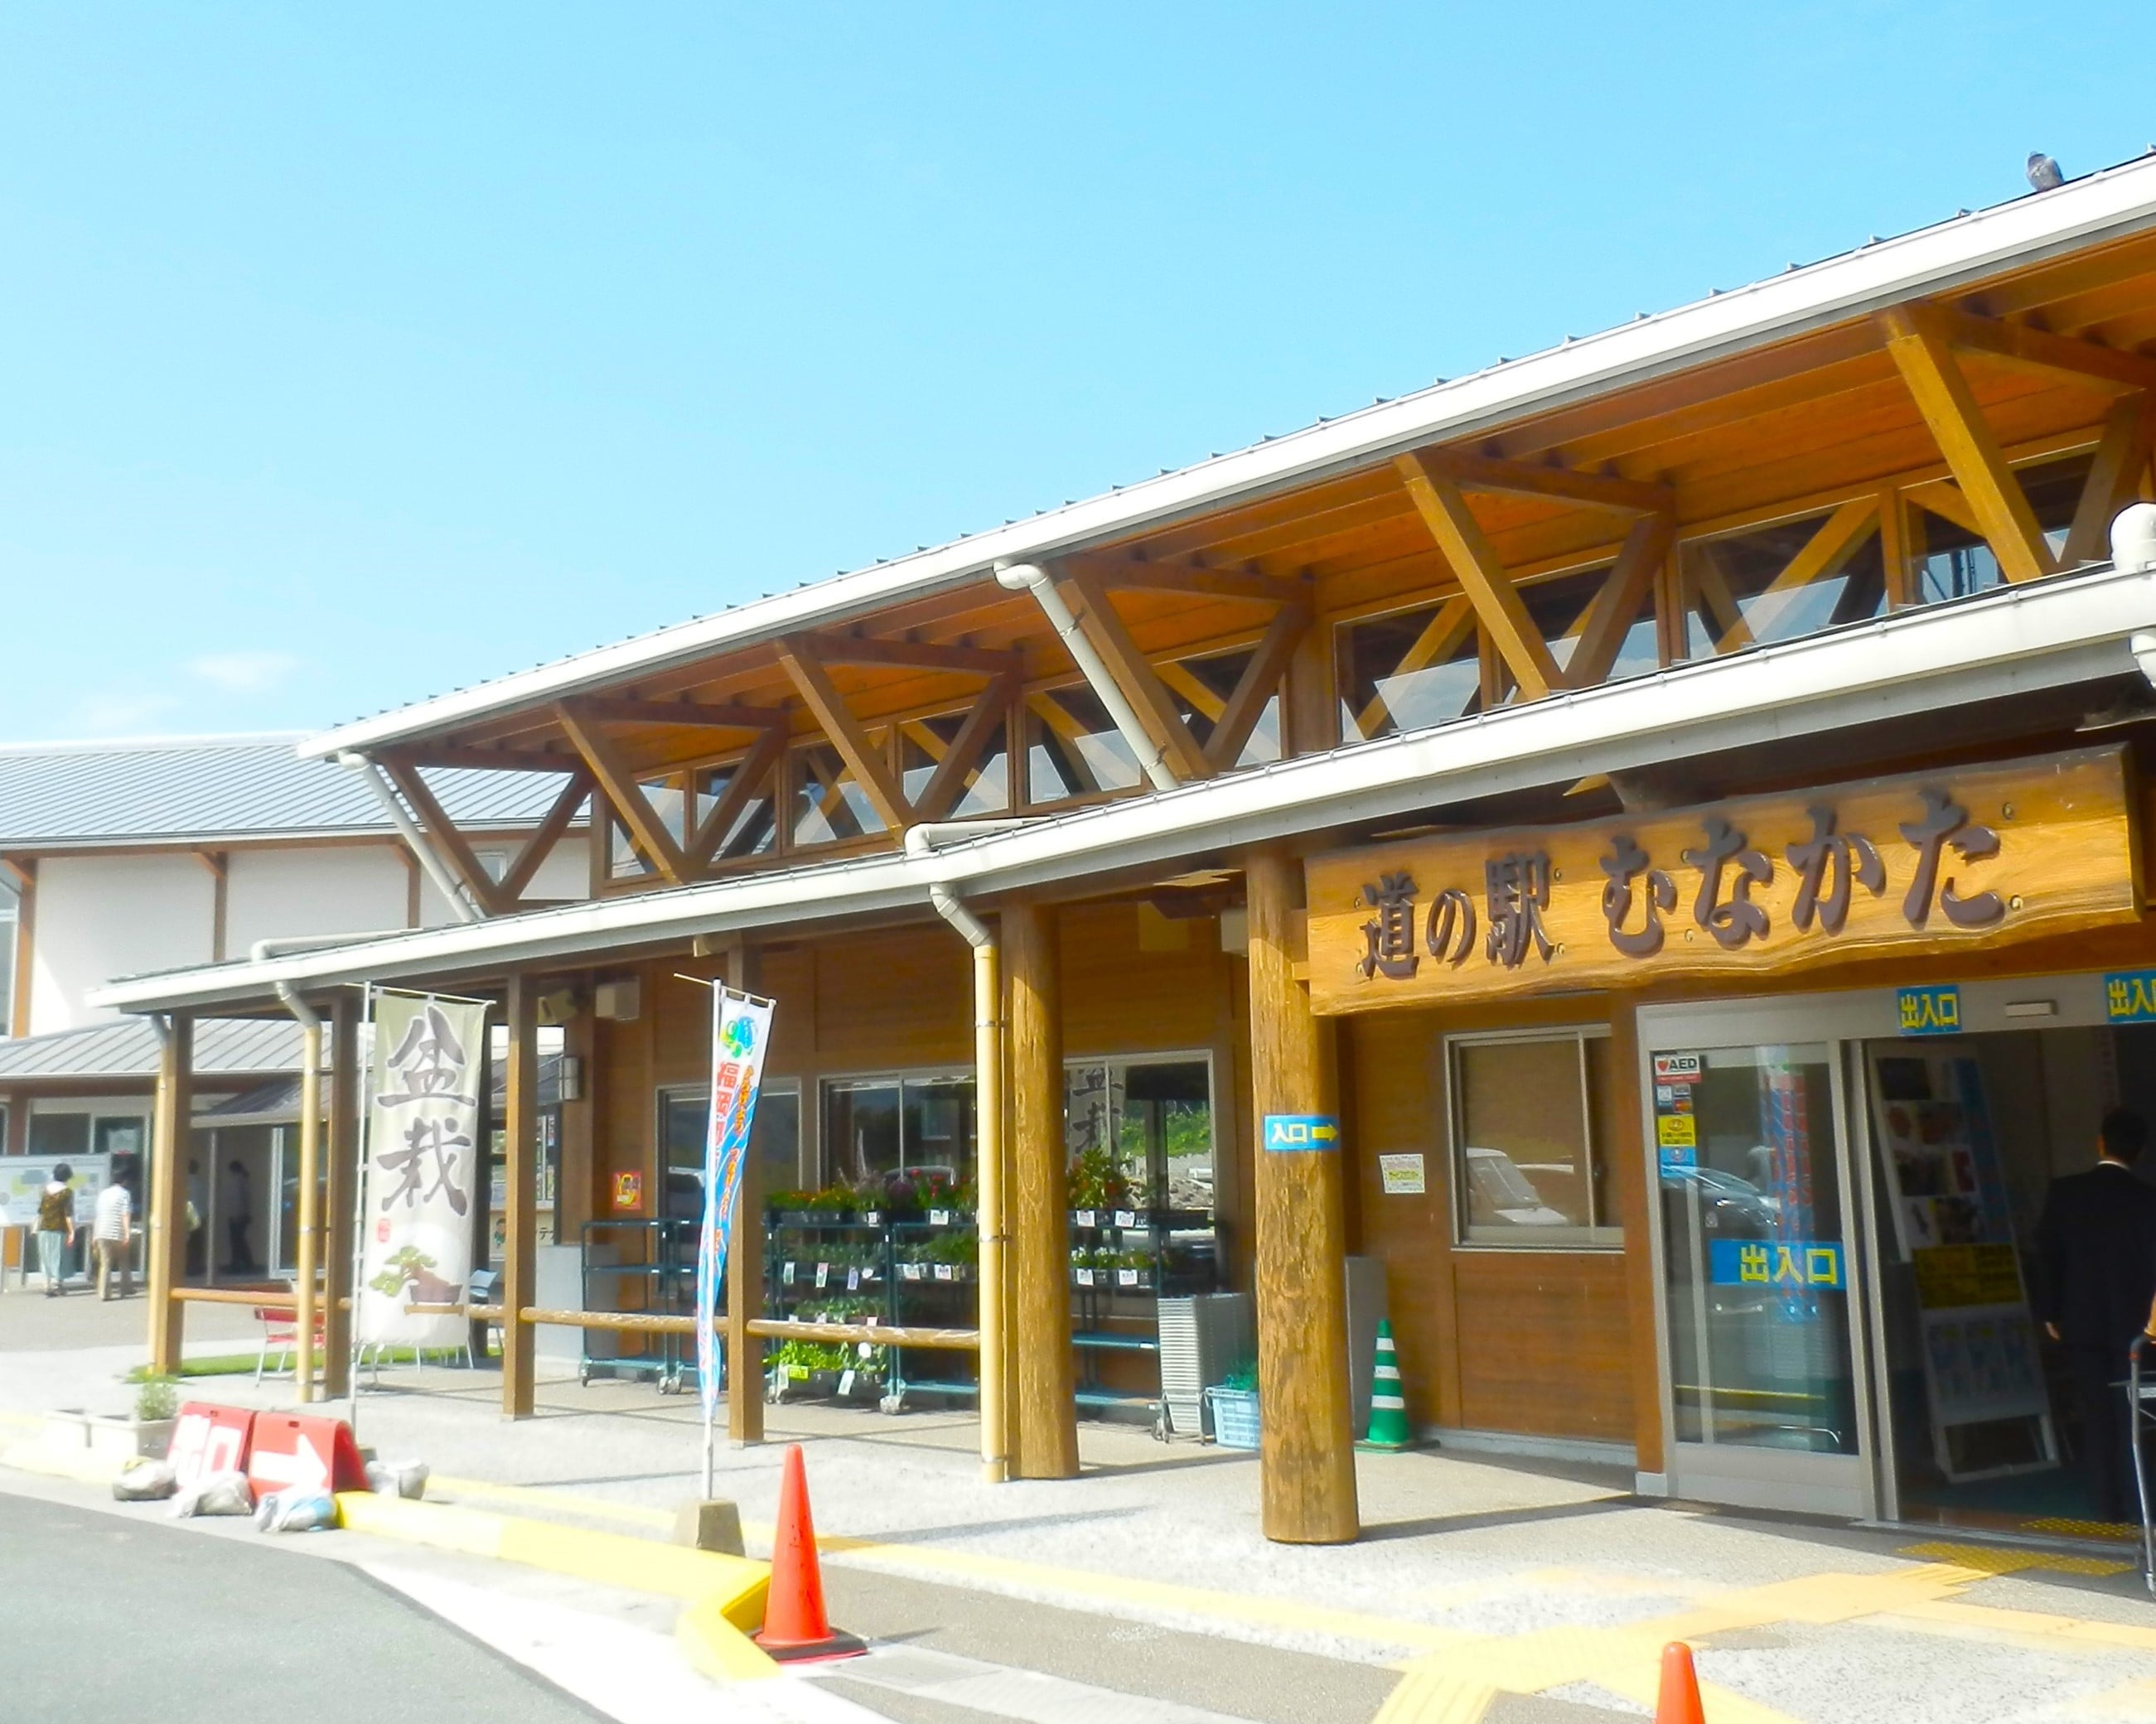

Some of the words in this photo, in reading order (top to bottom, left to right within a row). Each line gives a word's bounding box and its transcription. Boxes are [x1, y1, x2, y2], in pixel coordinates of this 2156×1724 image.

[1361, 852, 1555, 979] 道の駅
[1599, 785, 2006, 959] むなかた
[1900, 994, 1959, 1028] 出入口
[2108, 978, 2156, 1016] 出入
[1669, 1058, 1698, 1070] AED
[377, 1005, 476, 1216] 盆栽
[1271, 1123, 1308, 1143] 入口
[1741, 1244, 1838, 1284] 出入口
